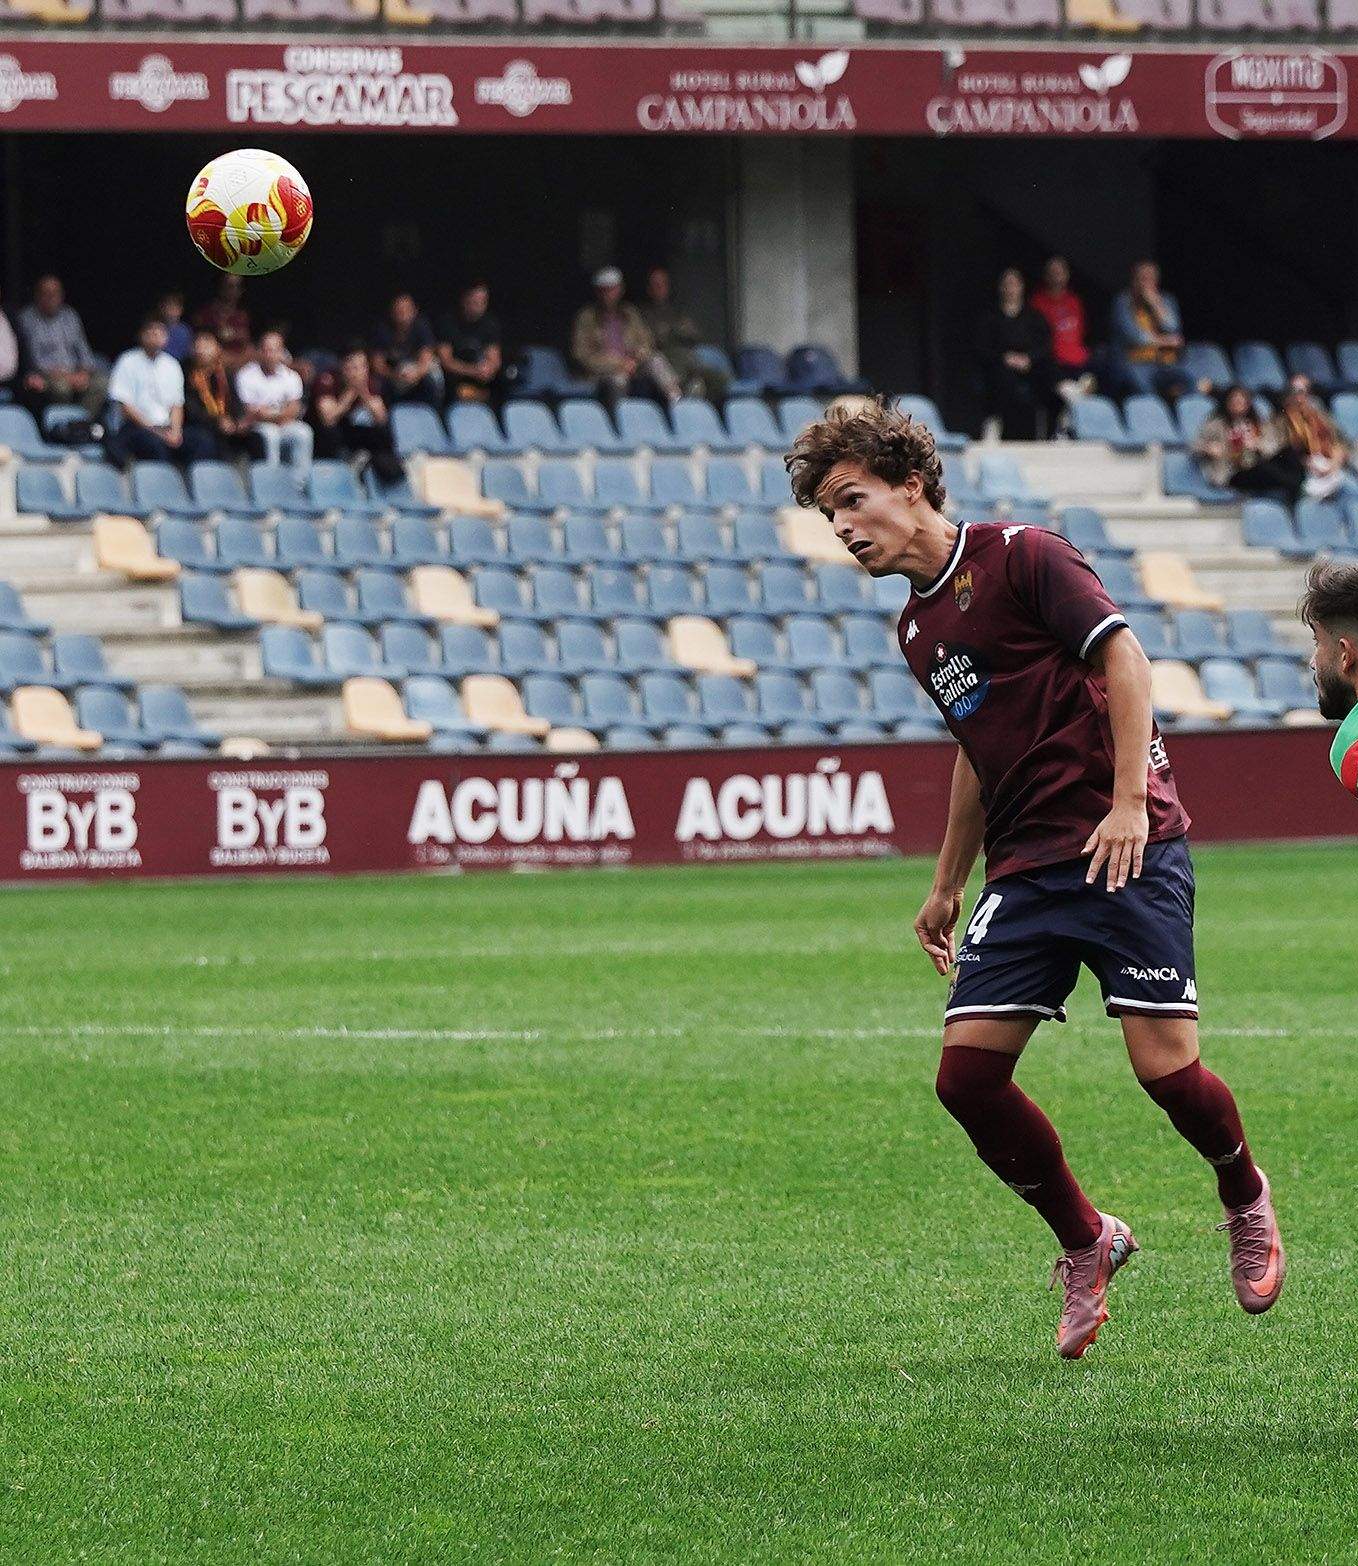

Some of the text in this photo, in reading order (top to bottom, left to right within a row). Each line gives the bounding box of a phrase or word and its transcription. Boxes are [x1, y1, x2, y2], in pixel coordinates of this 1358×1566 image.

[226, 69, 459, 126] PESCAMAR
[636, 94, 857, 131] CAMPANIOLA
[926, 97, 1140, 132] CAMPANIOLA
[930, 654, 973, 691] Estrella
[939, 672, 979, 707] Galicia
[407, 761, 636, 844] ACUÑA
[674, 756, 895, 842] ACUÑA
